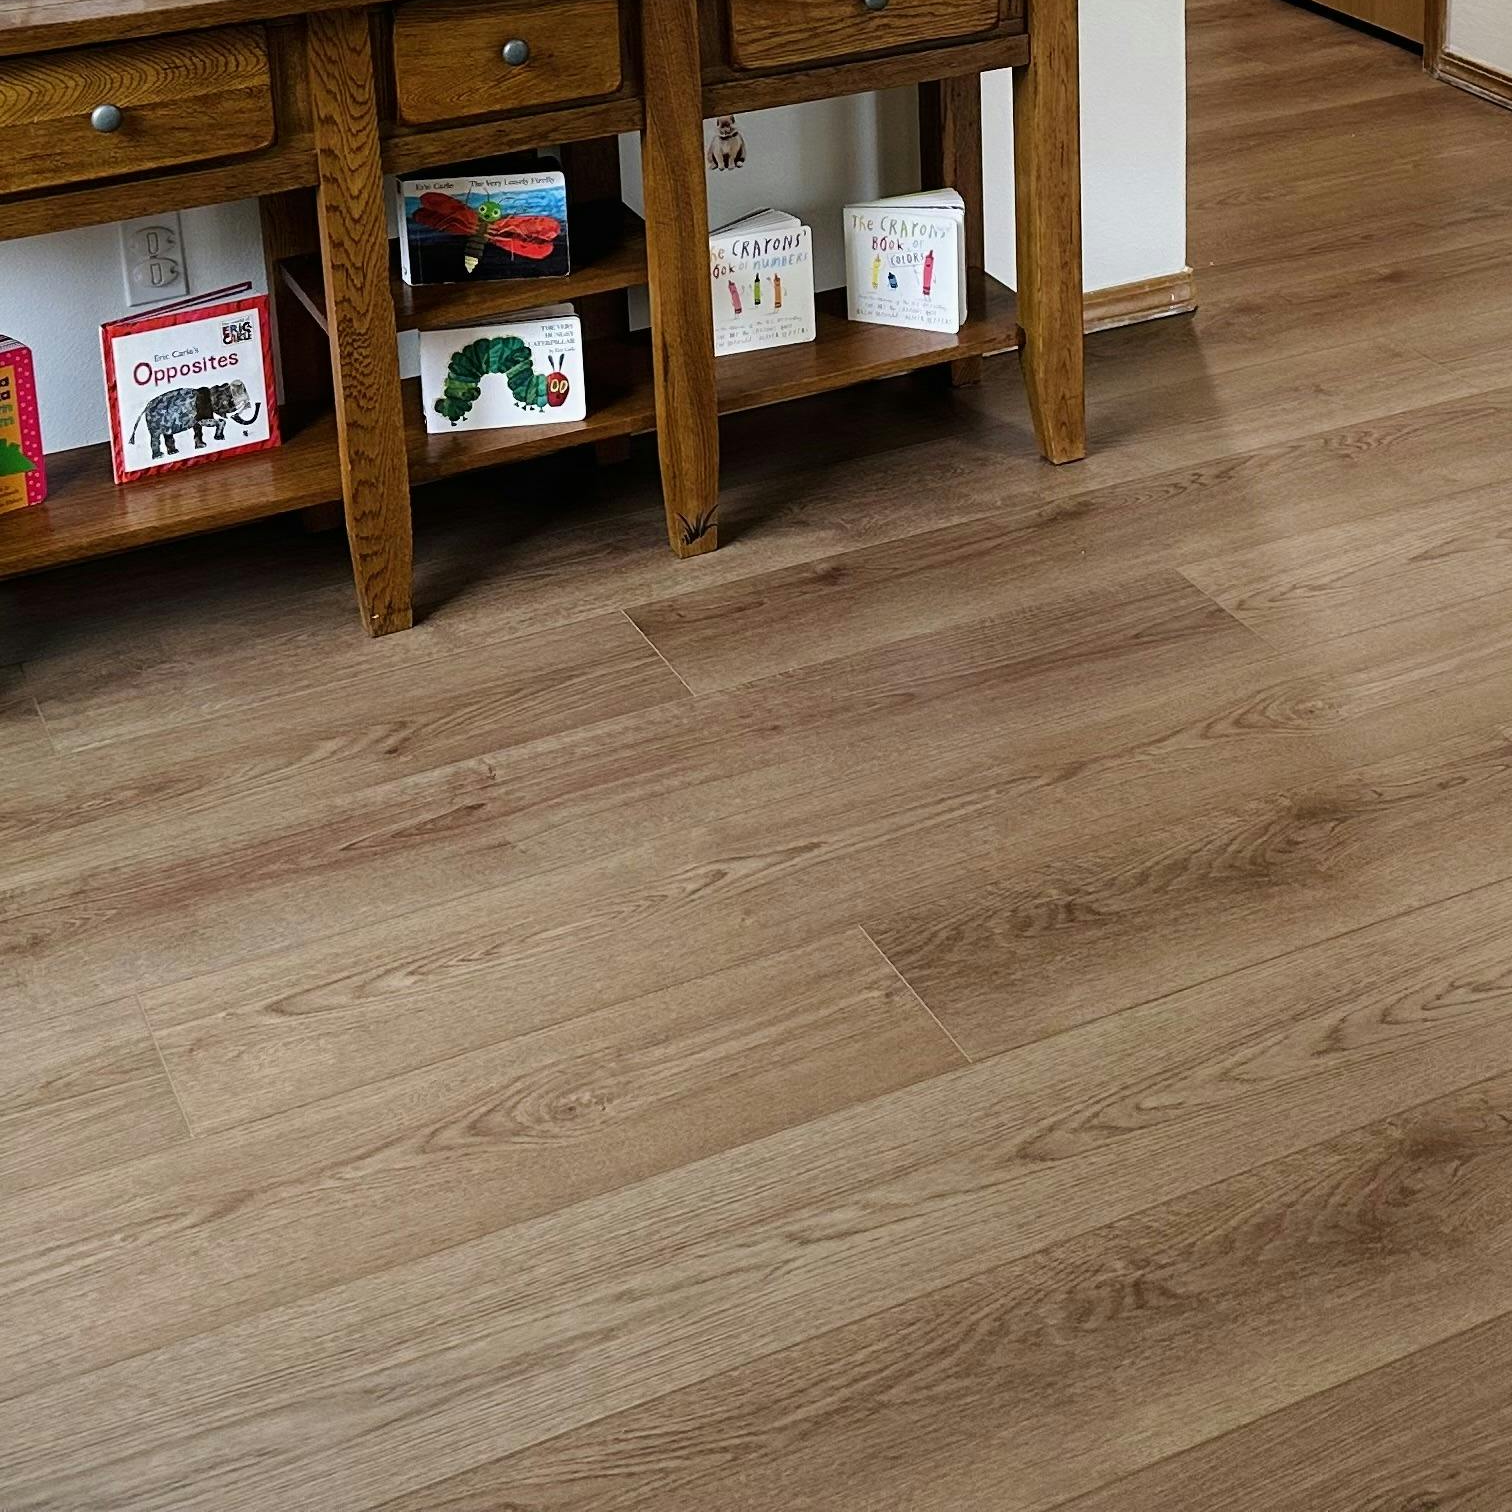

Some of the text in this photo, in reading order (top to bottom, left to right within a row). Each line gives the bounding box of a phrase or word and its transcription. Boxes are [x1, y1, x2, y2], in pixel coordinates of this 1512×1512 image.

[710, 247, 725, 262] he
[713, 264, 735, 279] ook
[154, 347, 199, 363] Eric Carle's
[133, 352, 239, 387] Opposites
